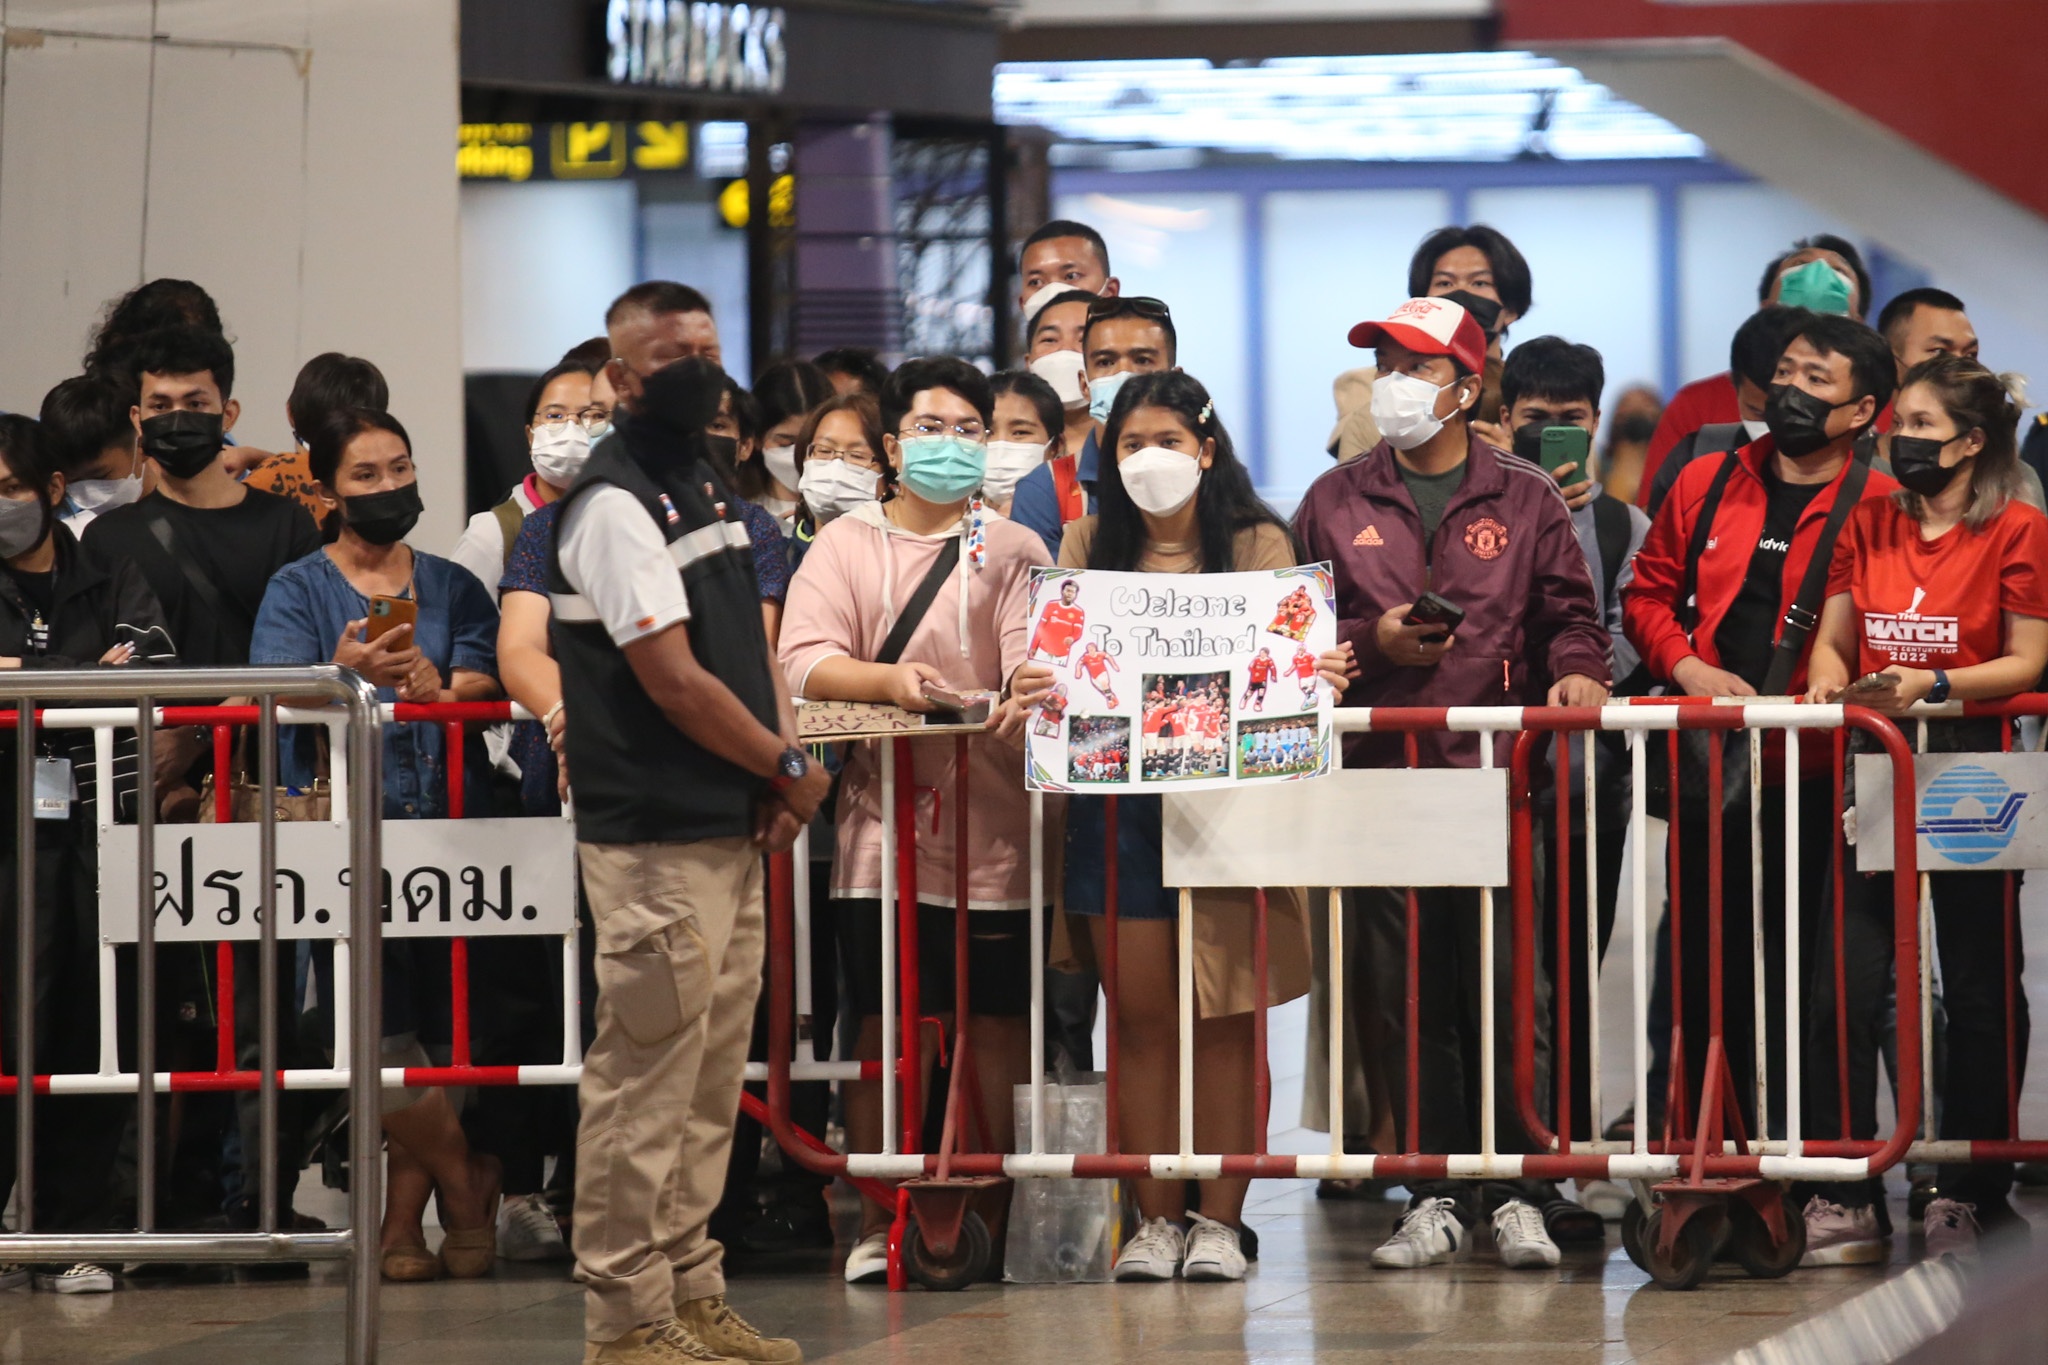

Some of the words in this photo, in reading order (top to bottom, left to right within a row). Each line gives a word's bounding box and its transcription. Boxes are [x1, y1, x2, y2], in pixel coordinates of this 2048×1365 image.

[1353, 538, 1384, 547] adidas
[1110, 586, 1247, 618] Welcome
[1897, 612, 1921, 621] THE
[1865, 619, 1958, 642] MATCH
[1089, 624, 1123, 656] To
[1130, 624, 1257, 657] Thailand
[1889, 652, 1928, 662] 2022
